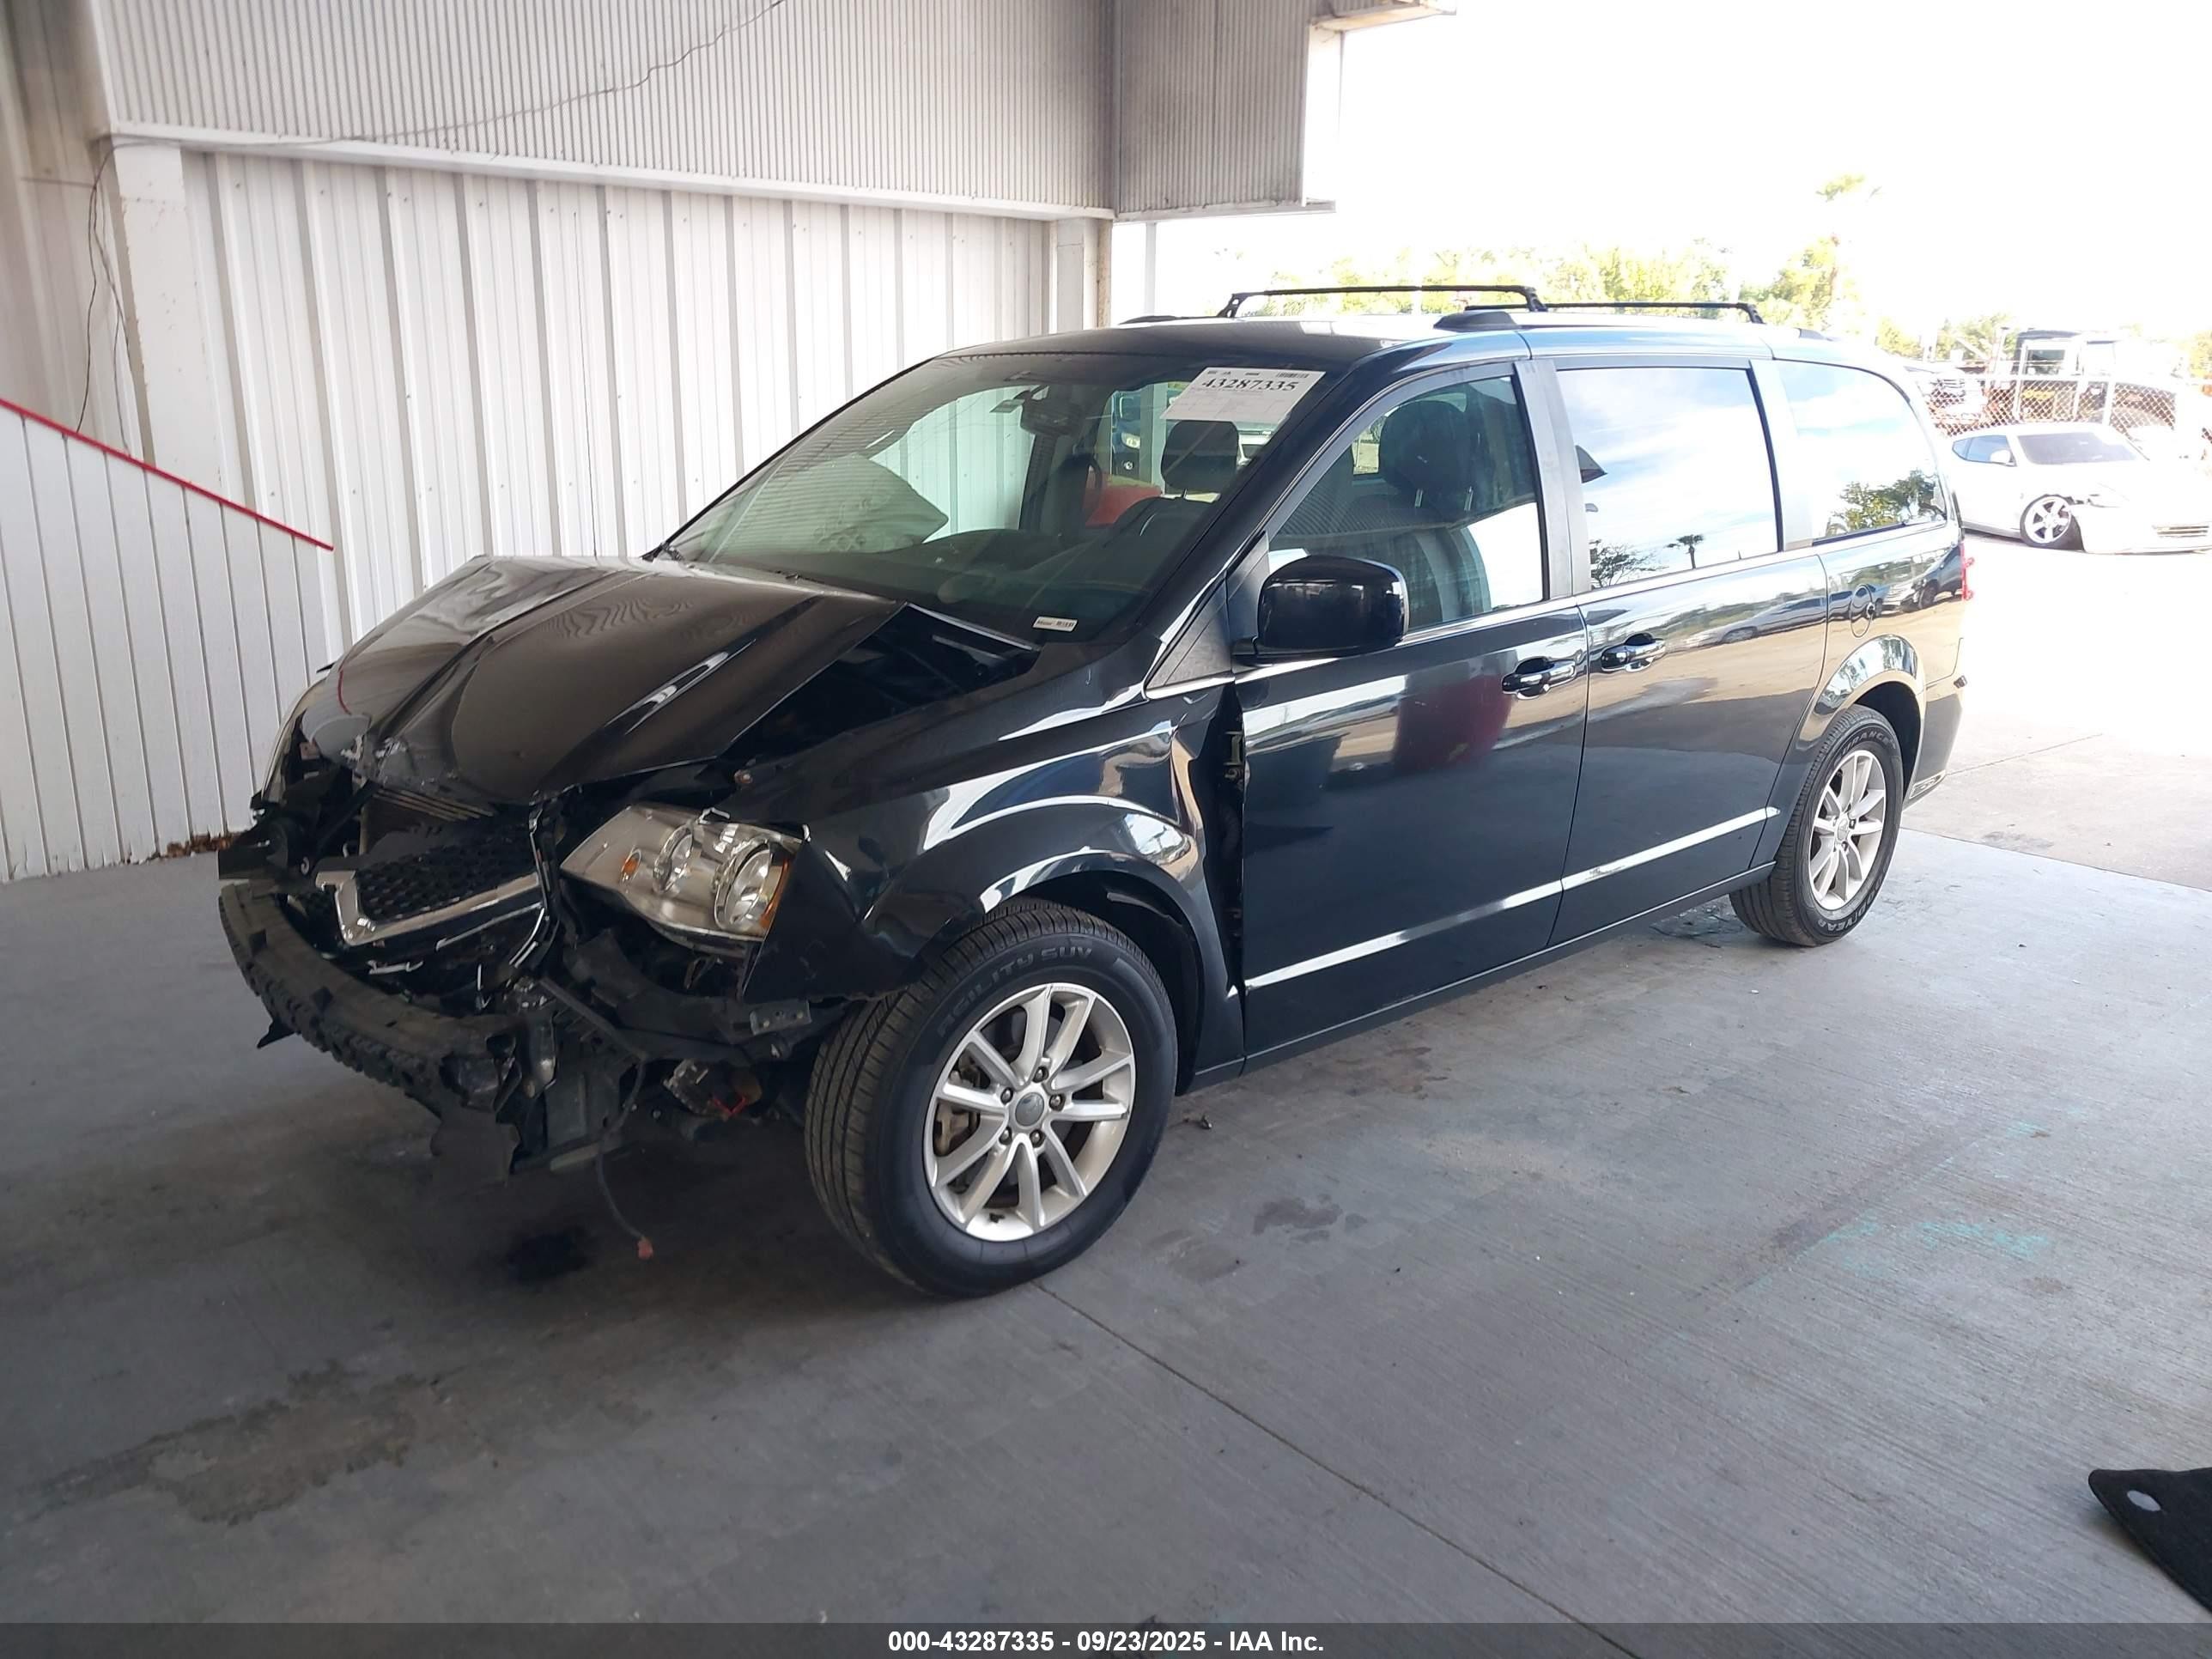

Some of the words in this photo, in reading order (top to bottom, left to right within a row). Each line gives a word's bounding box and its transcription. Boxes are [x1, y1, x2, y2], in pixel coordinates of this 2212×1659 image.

[1201, 378, 1299, 392] 43287335
[939, 953, 1034, 1036] AGILITY
[1041, 946, 1092, 961] SUV
